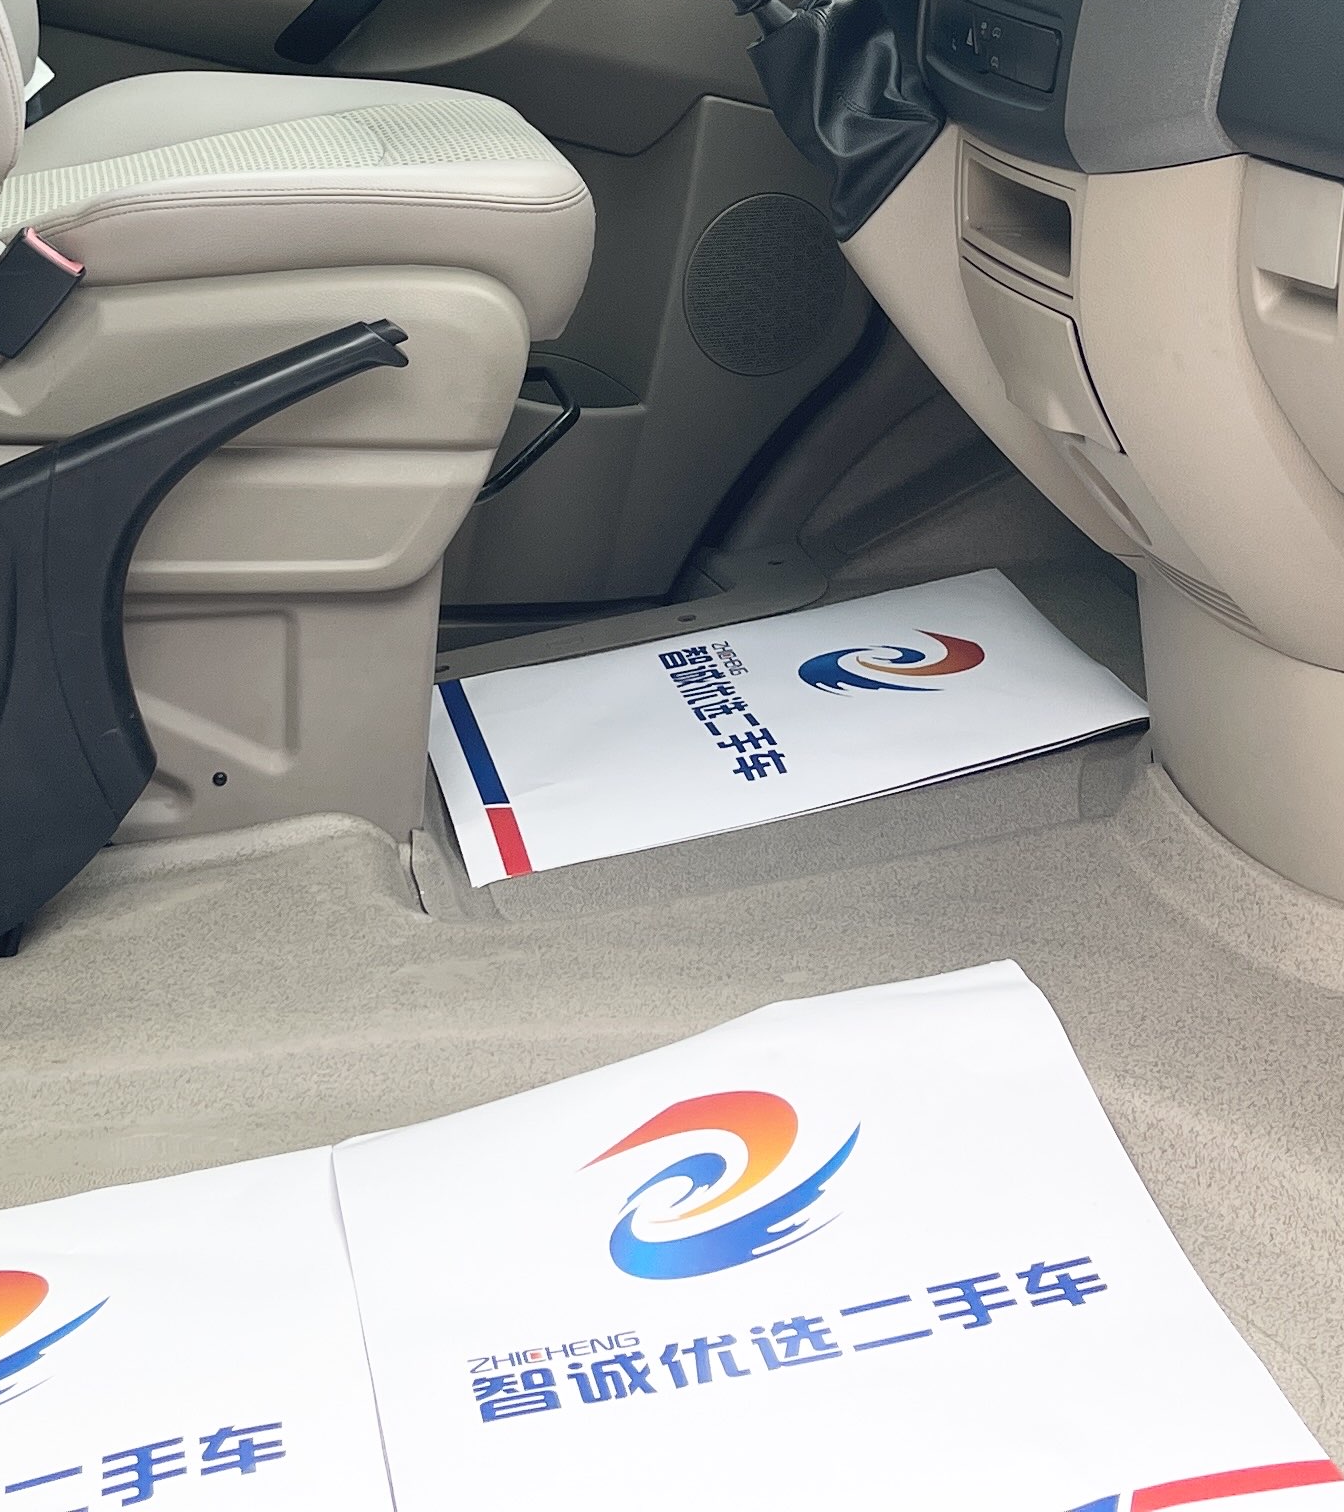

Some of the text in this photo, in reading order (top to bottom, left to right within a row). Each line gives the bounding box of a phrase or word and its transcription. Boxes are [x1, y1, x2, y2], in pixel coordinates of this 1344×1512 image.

[658, 645, 788, 782] 智诚优选二手车
[467, 1330, 642, 1374] ZHICHENG
[471, 1256, 1109, 1424] 智诚优选二手车
